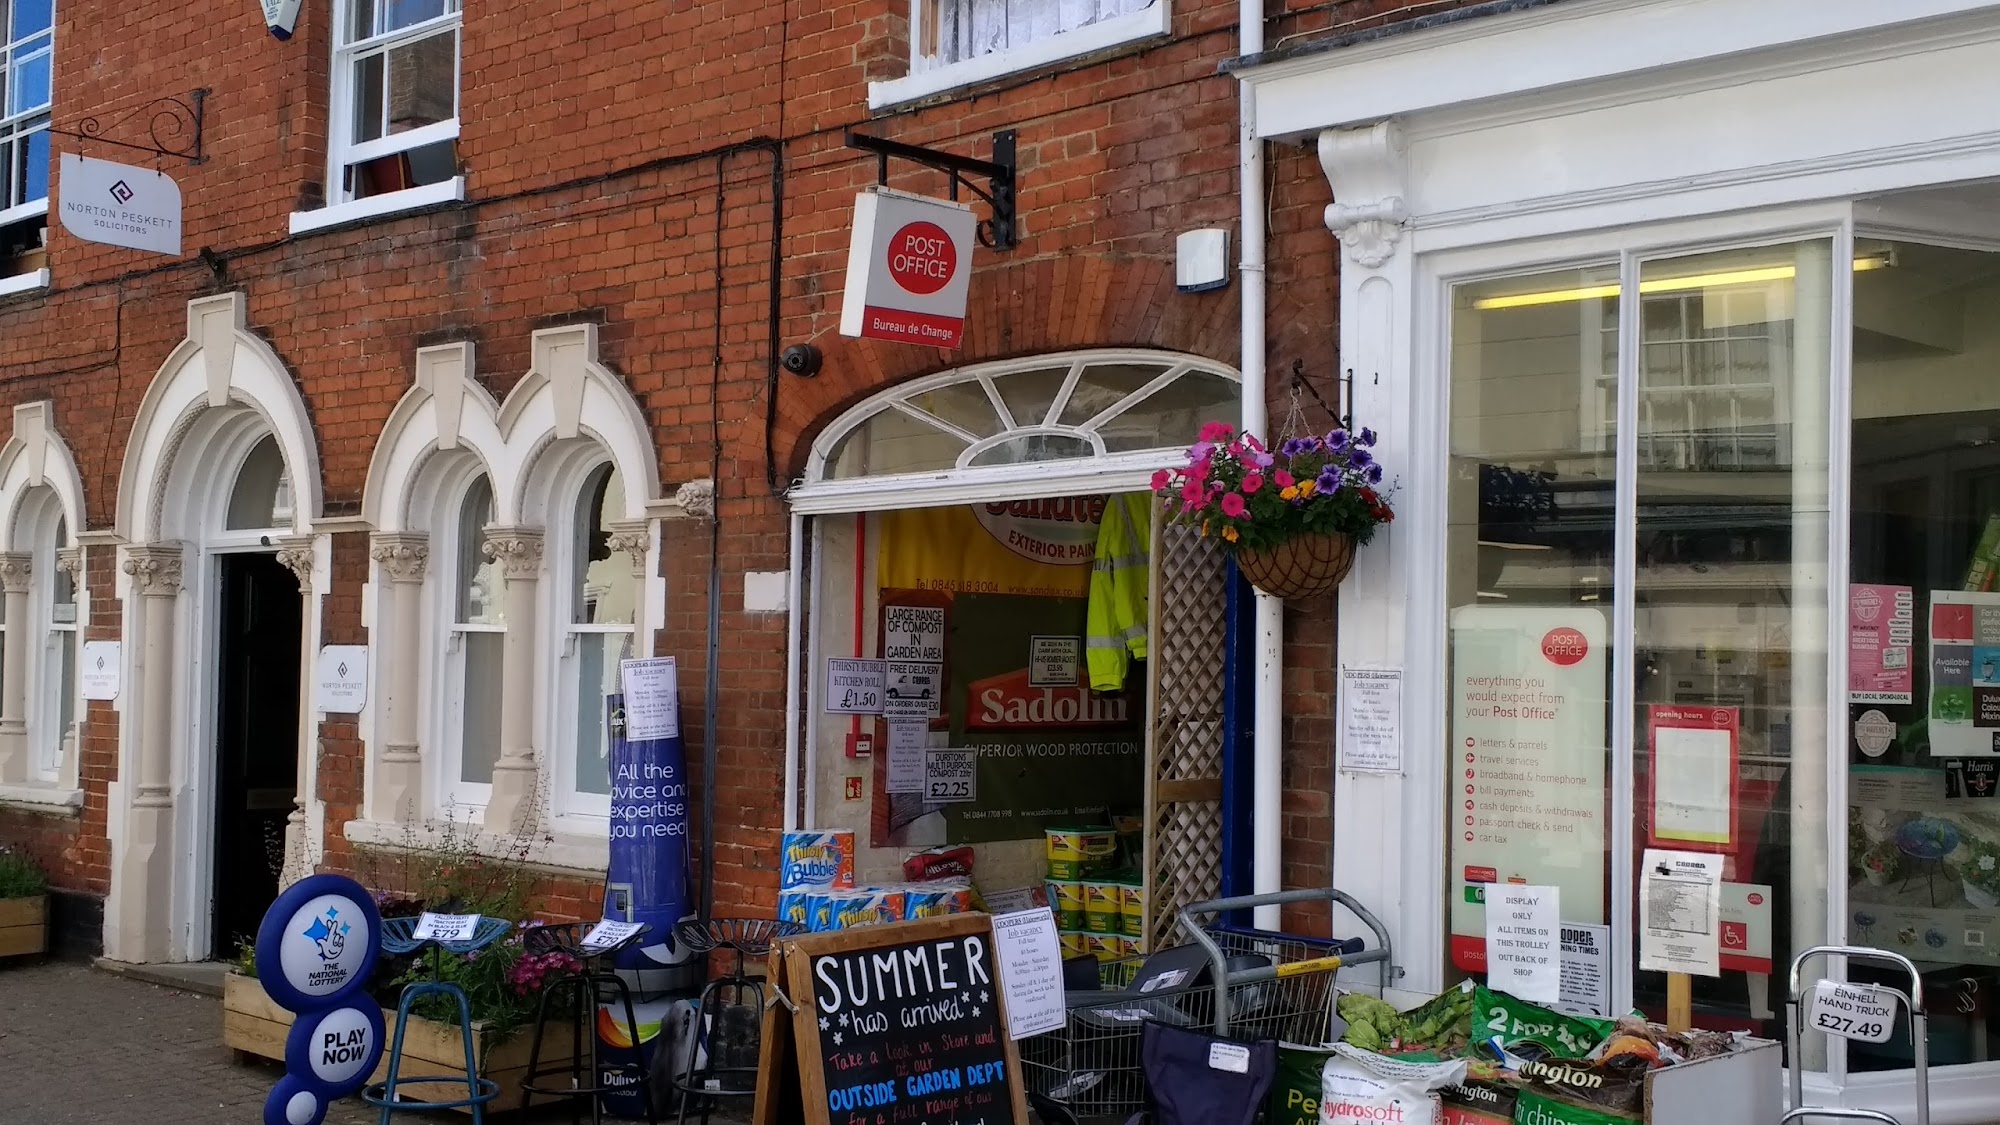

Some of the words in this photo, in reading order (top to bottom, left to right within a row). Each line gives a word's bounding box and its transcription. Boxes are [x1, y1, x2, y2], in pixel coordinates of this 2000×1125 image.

[68, 203, 116, 218] NORTON
[122, 212, 172, 228] PESKETT
[94, 220, 147, 234] SOLICITORS
[906, 235, 946, 257] POST
[894, 254, 947, 278] OFFICE
[873, 317, 905, 333] Bureau
[908, 323, 919, 334] de
[922, 324, 952, 340] Change
[1008, 529, 1064, 558] EXTERIOR
[1069, 542, 1096, 558] PAIN
[916, 578, 929, 590] Tel
[932, 579, 956, 592] 0845
[974, 581, 999, 593] 3004
[888, 608, 913, 620] LARGE
[916, 610, 942, 622] RANGE
[888, 621, 900, 632] OF
[903, 621, 942, 634] COMPOST
[910, 634, 920, 645] IN
[1552, 635, 1579, 645] POST
[887, 646, 920, 658] GARDEN
[923, 647, 941, 659] AREA
[1546, 646, 1582, 656] OFFICE
[831, 661, 860, 671] THIRSTY
[862, 662, 884, 673] BUBBLE
[890, 664, 907, 673] FREE
[909, 665, 939, 675] DELIVERY
[1935, 658, 1970, 667] Available
[834, 676, 864, 686] KITCHEN
[865, 677, 880, 687] ROLL
[1466, 675, 1521, 690] everything
[1525, 678, 1545, 690] you
[841, 689, 876, 708] £1.50
[1466, 690, 1497, 701] would
[1502, 692, 1535, 704] expect
[1539, 692, 1565, 704] from
[895, 700, 913, 708] ORDERS
[928, 702, 938, 710] £30
[1982, 703, 2000, 711] Colou
[1466, 707, 1490, 718] your
[1494, 705, 1518, 718] Post
[1522, 707, 1555, 720] Office
[1655, 710, 1682, 721] opening
[1684, 711, 1703, 719] hours
[1981, 712, 2000, 720] Mixin
[1026, 743, 1065, 757] WOOD
[1069, 742, 1138, 755] PROTECTION
[1480, 738, 1506, 748] letters
[1509, 740, 1515, 748] &
[1518, 740, 1548, 751] parcels
[928, 762, 946, 770] MULTI
[1480, 754, 1503, 764] travel
[1506, 756, 1540, 766] services
[1967, 760, 1994, 771] Harris
[617, 764, 639, 780] All
[644, 763, 674, 780] the
[1480, 770, 1524, 781] broadband
[1527, 772, 1534, 780] &
[1536, 773, 1587, 785] homephone
[612, 783, 657, 799] dvice
[931, 782, 969, 796] £2.25
[1480, 786, 1492, 795] bill
[1494, 787, 1534, 798] payments
[611, 801, 684, 822] expertise
[1479, 802, 1498, 811] cash
[1500, 803, 1533, 814] deposits
[1535, 805, 1542, 814] &
[1544, 806, 1593, 818] withdrawals
[1479, 818, 1514, 828] passport
[1518, 819, 1541, 830] check
[1544, 822, 1550, 831] &
[1553, 823, 1573, 833] send
[610, 825, 636, 841] you
[1479, 833, 1492, 842] car
[1494, 834, 1508, 844] tax
[788, 844, 824, 862] Thirsty
[843, 837, 853, 852] 3
[792, 860, 838, 882] Bubbles
[1506, 897, 1539, 905] DISPLAY
[1512, 912, 1532, 920] ONLY
[997, 919, 1021, 929] COOPERS
[1497, 925, 1512, 933] ALL
[1514, 926, 1536, 935] ITEMS
[1538, 928, 1549, 936] ON
[431, 929, 460, 938] £79
[1008, 929, 1020, 939] Job
[1020, 926, 1043, 936] vacancy
[1560, 928, 1594, 946] oopers
[594, 935, 619, 945] £79
[1496, 938, 1514, 947] THIS
[1515, 940, 1550, 949] TROLLEY
[1560, 944, 1577, 952] NING
[1578, 946, 1599, 955] TIMES
[1498, 953, 1514, 961] OUT
[1515, 954, 1536, 964] BACK
[1538, 956, 1548, 964] OF
[323, 962, 339, 971] THE
[1513, 968, 1533, 976] SHOP
[308, 968, 348, 980] NATIONAL
[815, 935, 989, 1014] SUMMER
[309, 976, 344, 987] LOTTERY
[1834, 988, 1878, 1004] EINHELL
[1818, 996, 1852, 1012] HAND
[1855, 1005, 1890, 1017] TRUCK
[851, 1010, 888, 1036] has
[900, 992, 964, 1028] arrived
[1487, 1007, 1508, 1032] 2
[1511, 1018, 1553, 1037] FOR
[1818, 1013, 1883, 1037] £27.49
[324, 1028, 366, 1049] PLAY
[828, 1056, 864, 1071] Take
[870, 1050, 878, 1064] a
[885, 1042, 912, 1061] look
[919, 1040, 932, 1054] in
[942, 1035, 969, 1052] Store
[975, 1025, 995, 1045] and
[323, 1045, 366, 1066] NOW
[896, 1062, 909, 1076] at
[915, 1058, 934, 1072] our
[830, 1079, 897, 1111] OUTSIDE
[906, 1068, 961, 1097] GARDEN
[967, 1060, 1005, 1085] DEPT
[849, 1112, 866, 1125] for
[877, 1114, 885, 1125] a
[893, 1105, 917, 1121] full
[926, 1098, 959, 1123] range
[965, 1095, 974, 1108] of
[977, 1093, 992, 1104] our
[1324, 1100, 1403, 1123] hydrosoft
